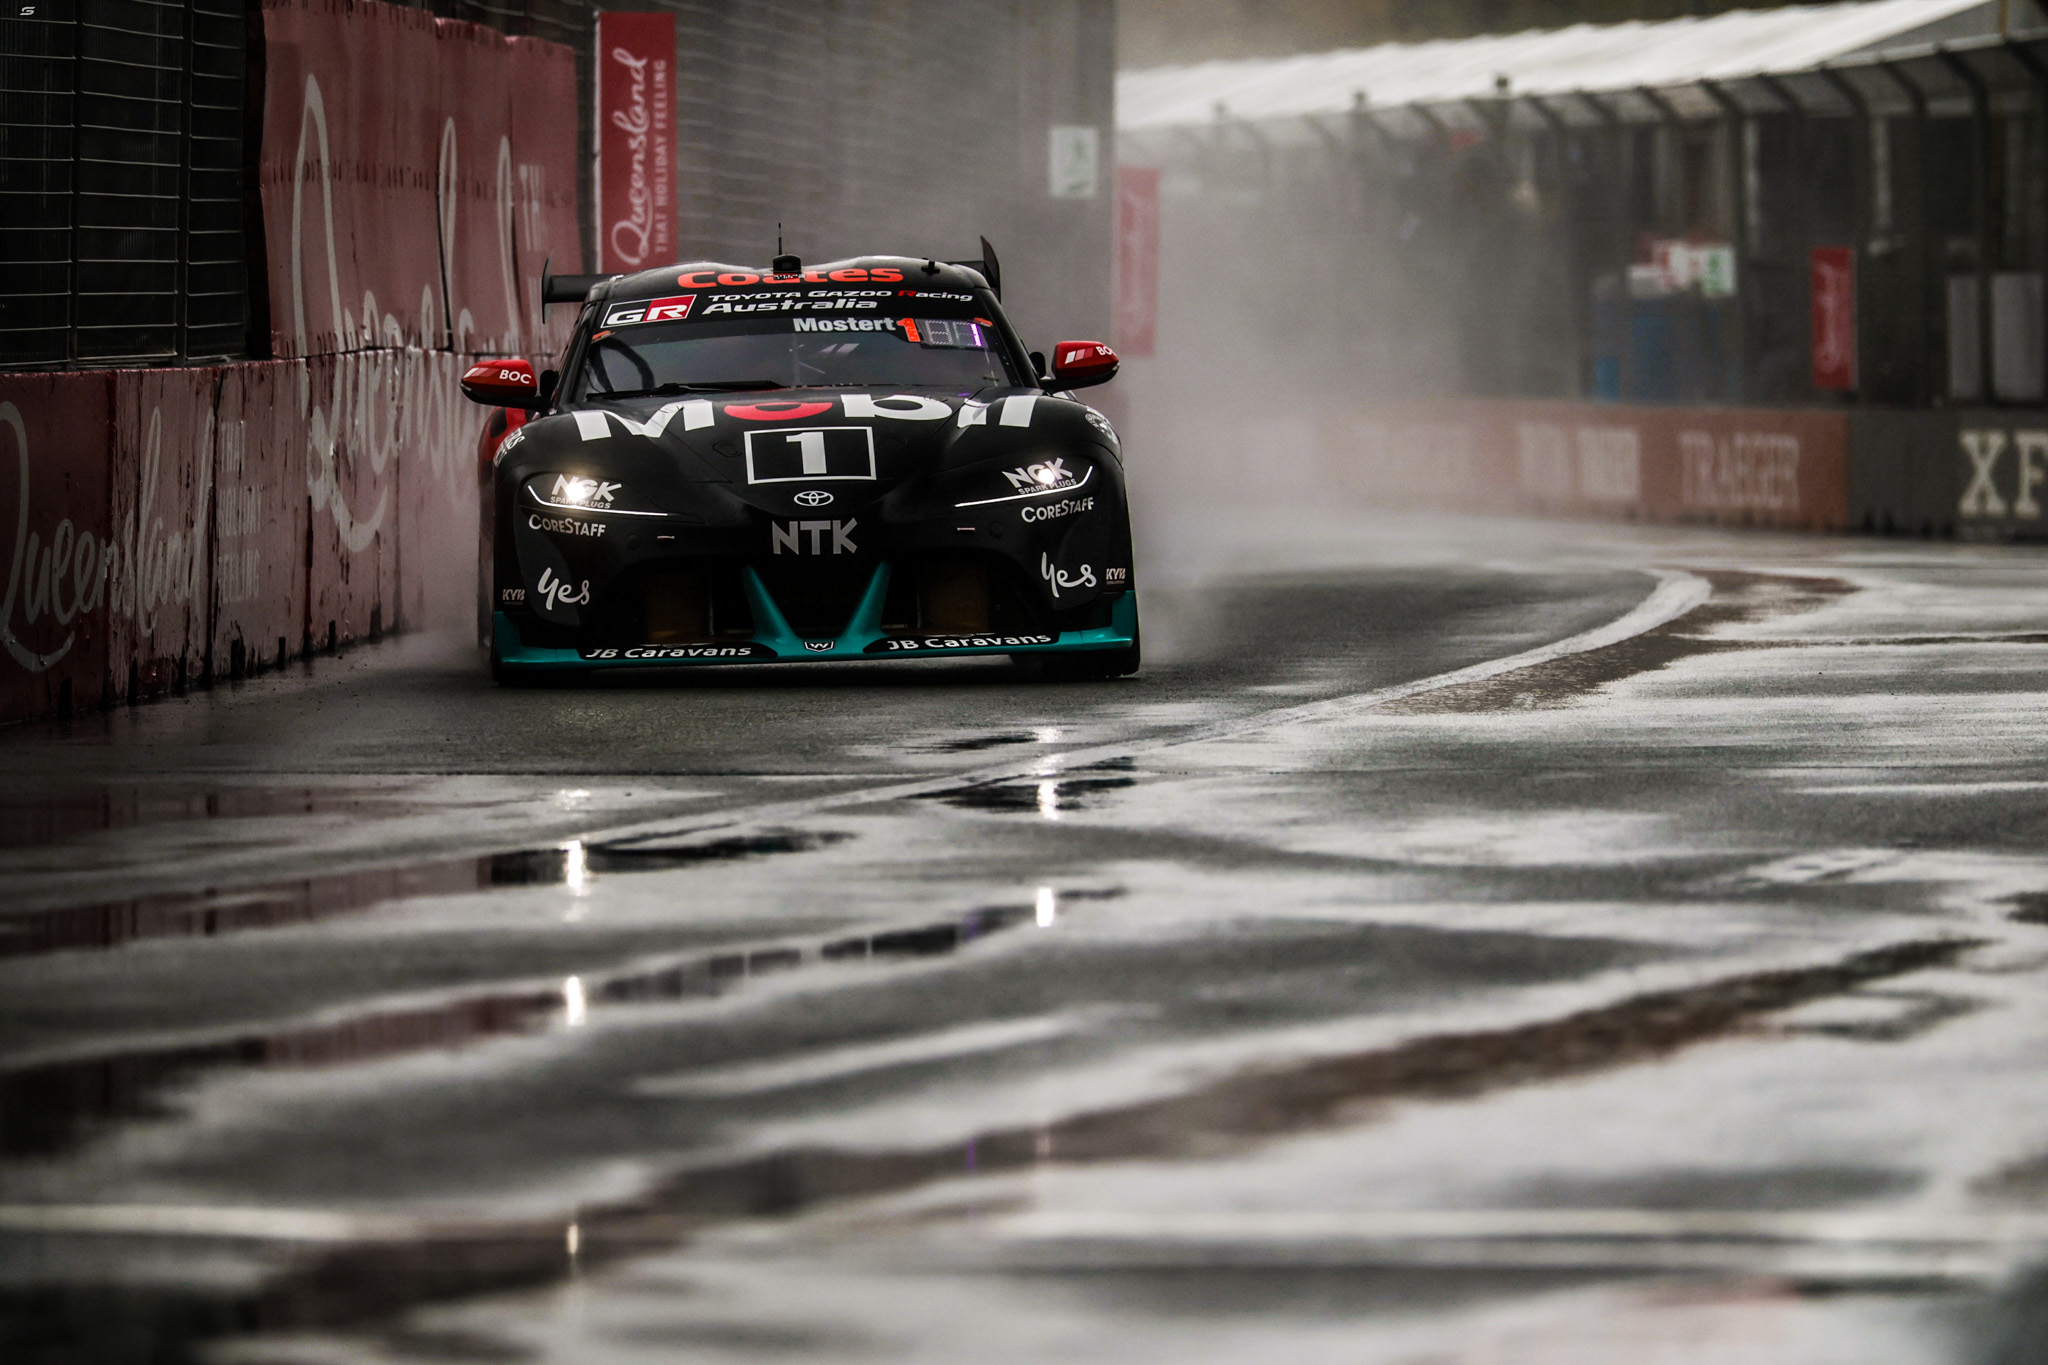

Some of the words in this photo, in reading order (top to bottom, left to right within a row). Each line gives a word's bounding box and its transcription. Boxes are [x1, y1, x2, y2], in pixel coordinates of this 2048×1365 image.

[652, 58, 668, 129] FEELING
[611, 46, 653, 265] Queensland
[653, 136, 668, 206] HOLIDAY
[654, 213, 668, 253] THAT
[678, 268, 904, 289] Coates
[702, 299, 878, 316] Australia
[708, 292, 801, 302] TOYOTA
[808, 290, 893, 298] GAZOO
[898, 290, 974, 303] Racing
[604, 304, 688, 325] GR
[793, 318, 896, 332] Mostert
[896, 318, 920, 342] 1
[499, 369, 532, 384] BOC
[572, 394, 1041, 441] Mobil
[786, 431, 827, 475] 1
[1002, 457, 1073, 489] NGK
[551, 473, 622, 502] NGK
[1018, 484, 1048, 495] SPARK
[1049, 478, 1077, 490] PLUGS
[550, 496, 579, 507] SPARK
[581, 500, 612, 509] PLUGS
[772, 517, 858, 555] NTK
[586, 648, 618, 658] JB
[624, 646, 752, 658] Caravans
[887, 640, 919, 650] JB
[924, 634, 1051, 648] Caravans
